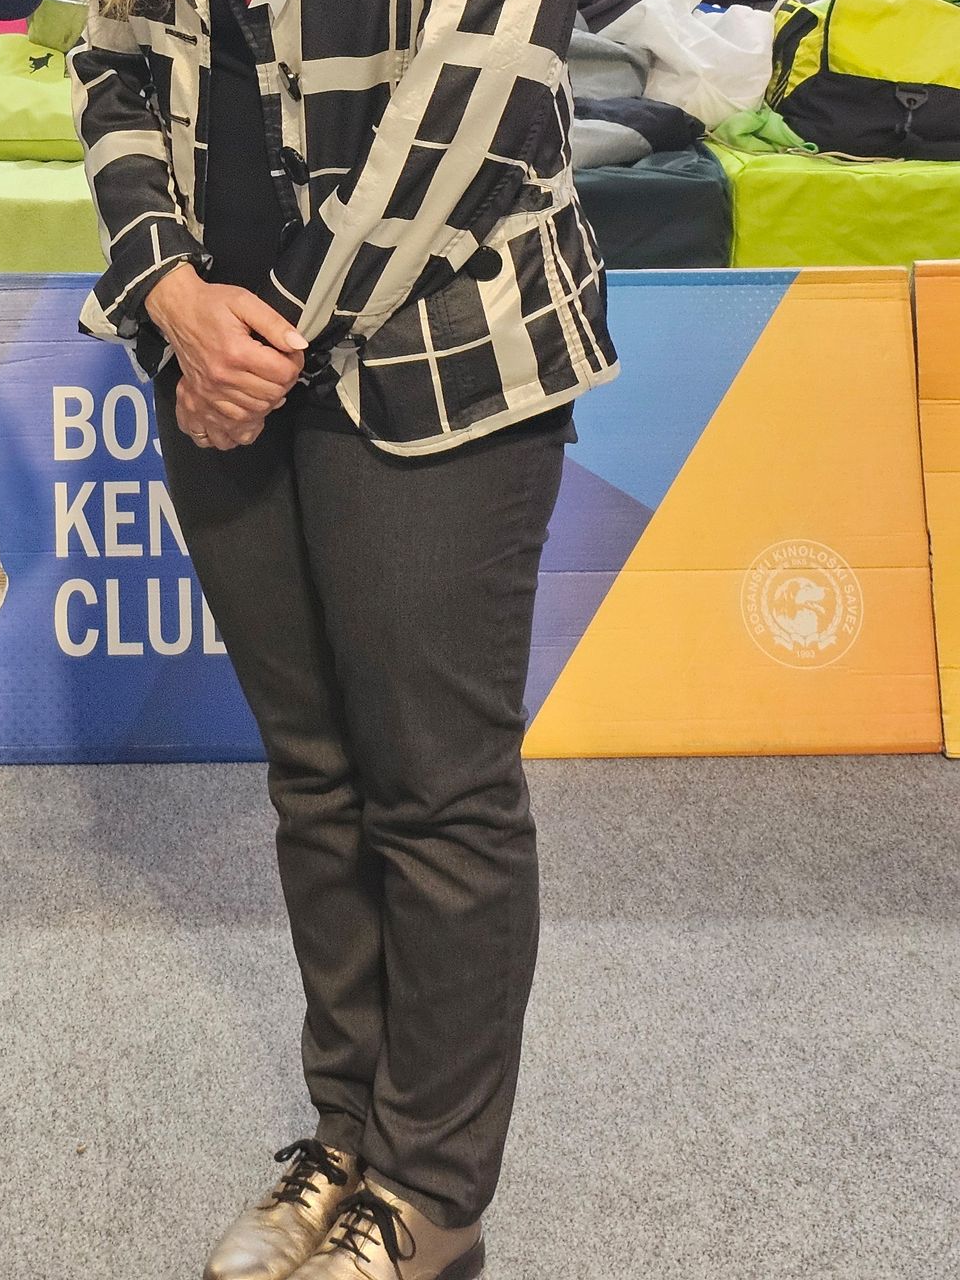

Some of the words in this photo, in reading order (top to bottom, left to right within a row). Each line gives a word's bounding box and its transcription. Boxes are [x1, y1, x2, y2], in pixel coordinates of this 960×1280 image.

[53, 384, 163, 460] BO
[747, 559, 772, 635] BOSANSKI
[843, 584, 858, 634] SAVEZ
